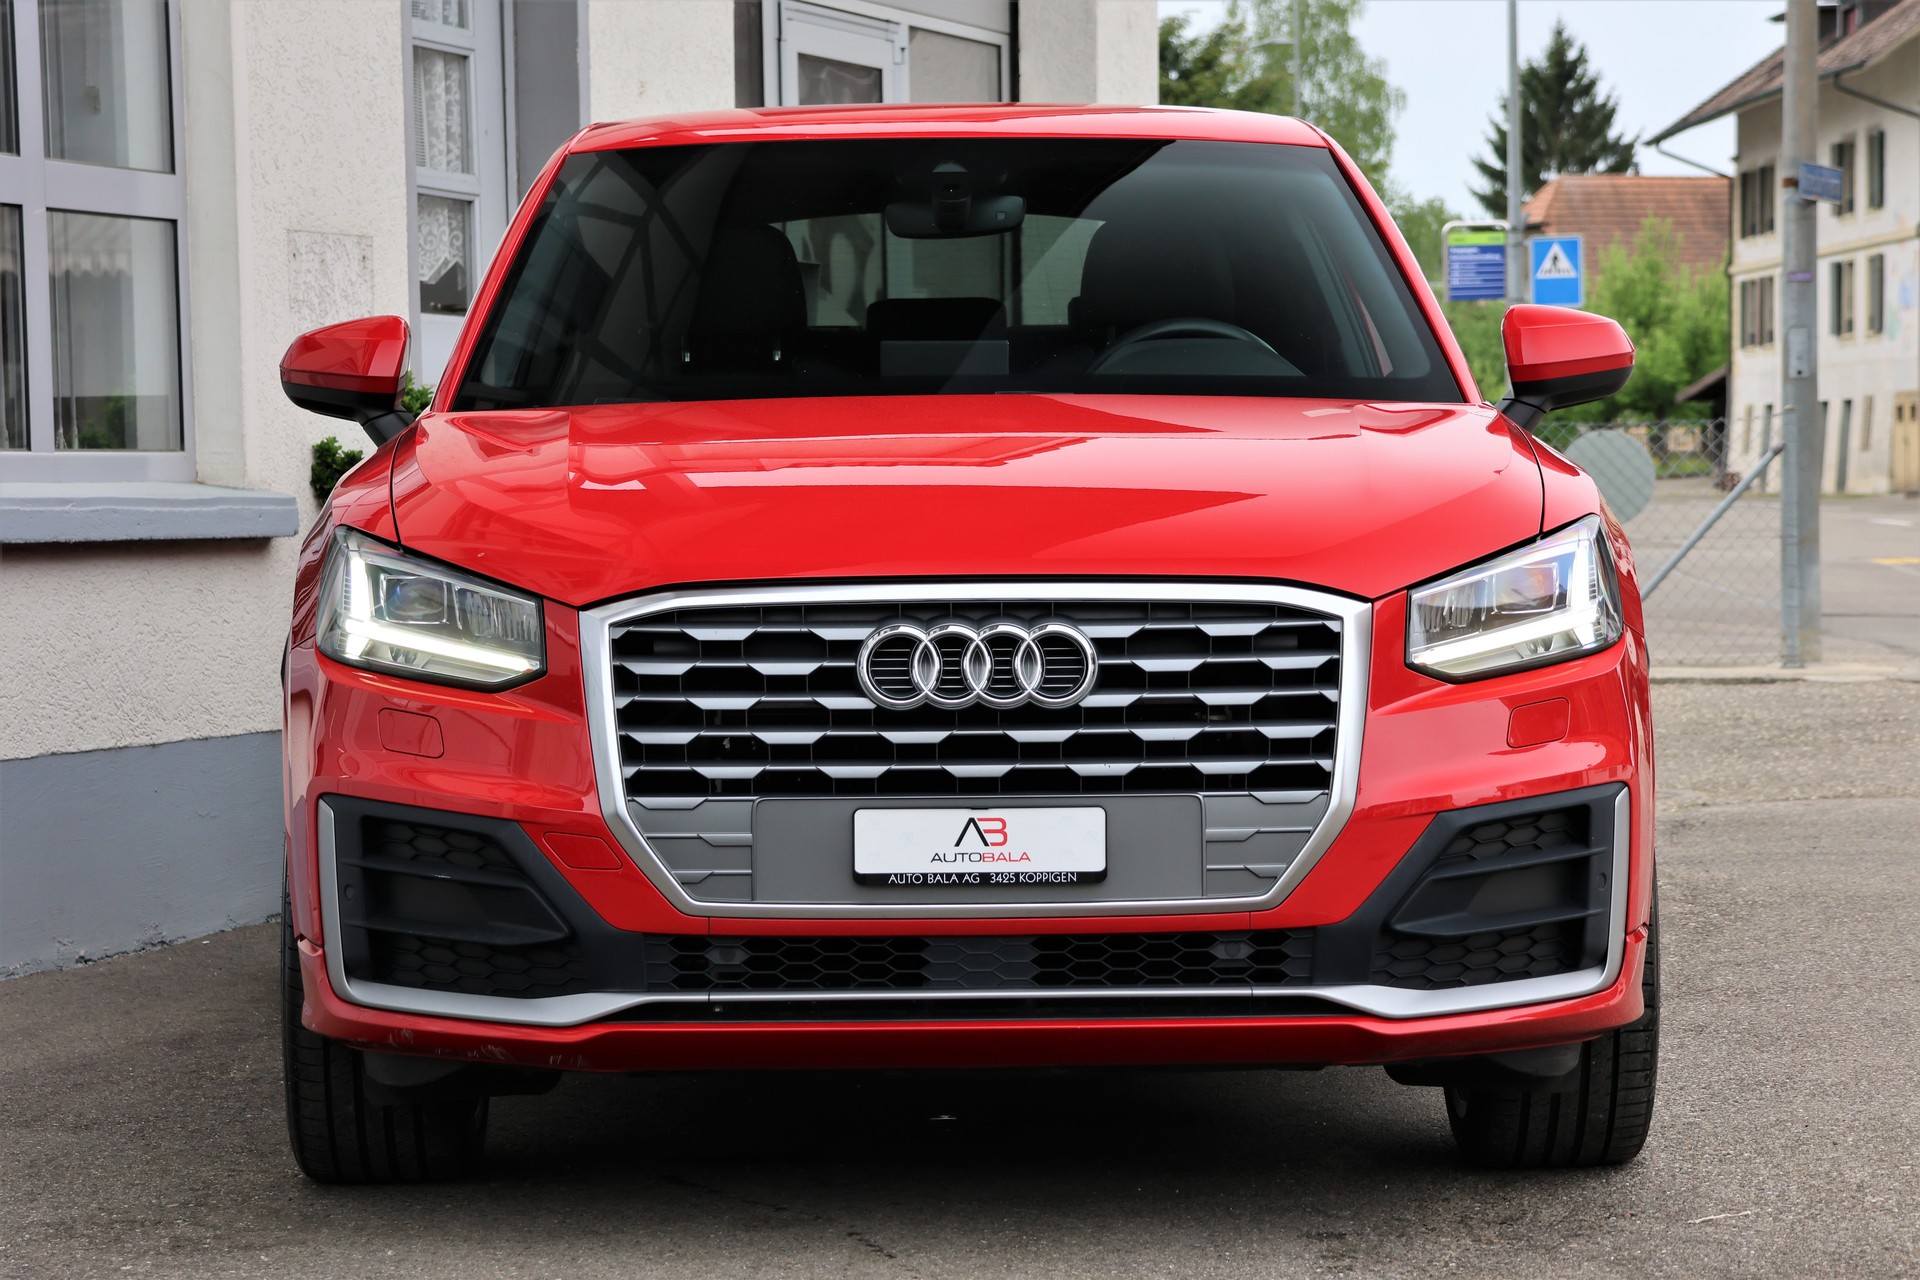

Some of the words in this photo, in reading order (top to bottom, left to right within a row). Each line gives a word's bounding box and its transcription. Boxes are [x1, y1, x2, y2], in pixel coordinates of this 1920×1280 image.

[954, 817, 1008, 847] AB
[930, 852, 1031, 863] AUTOBALA
[888, 873, 923, 884] AUTO
[927, 873, 959, 884] BALA
[962, 872, 980, 884] AG
[990, 872, 1016, 883] 3425
[1019, 871, 1077, 883] KOPPIGEN
